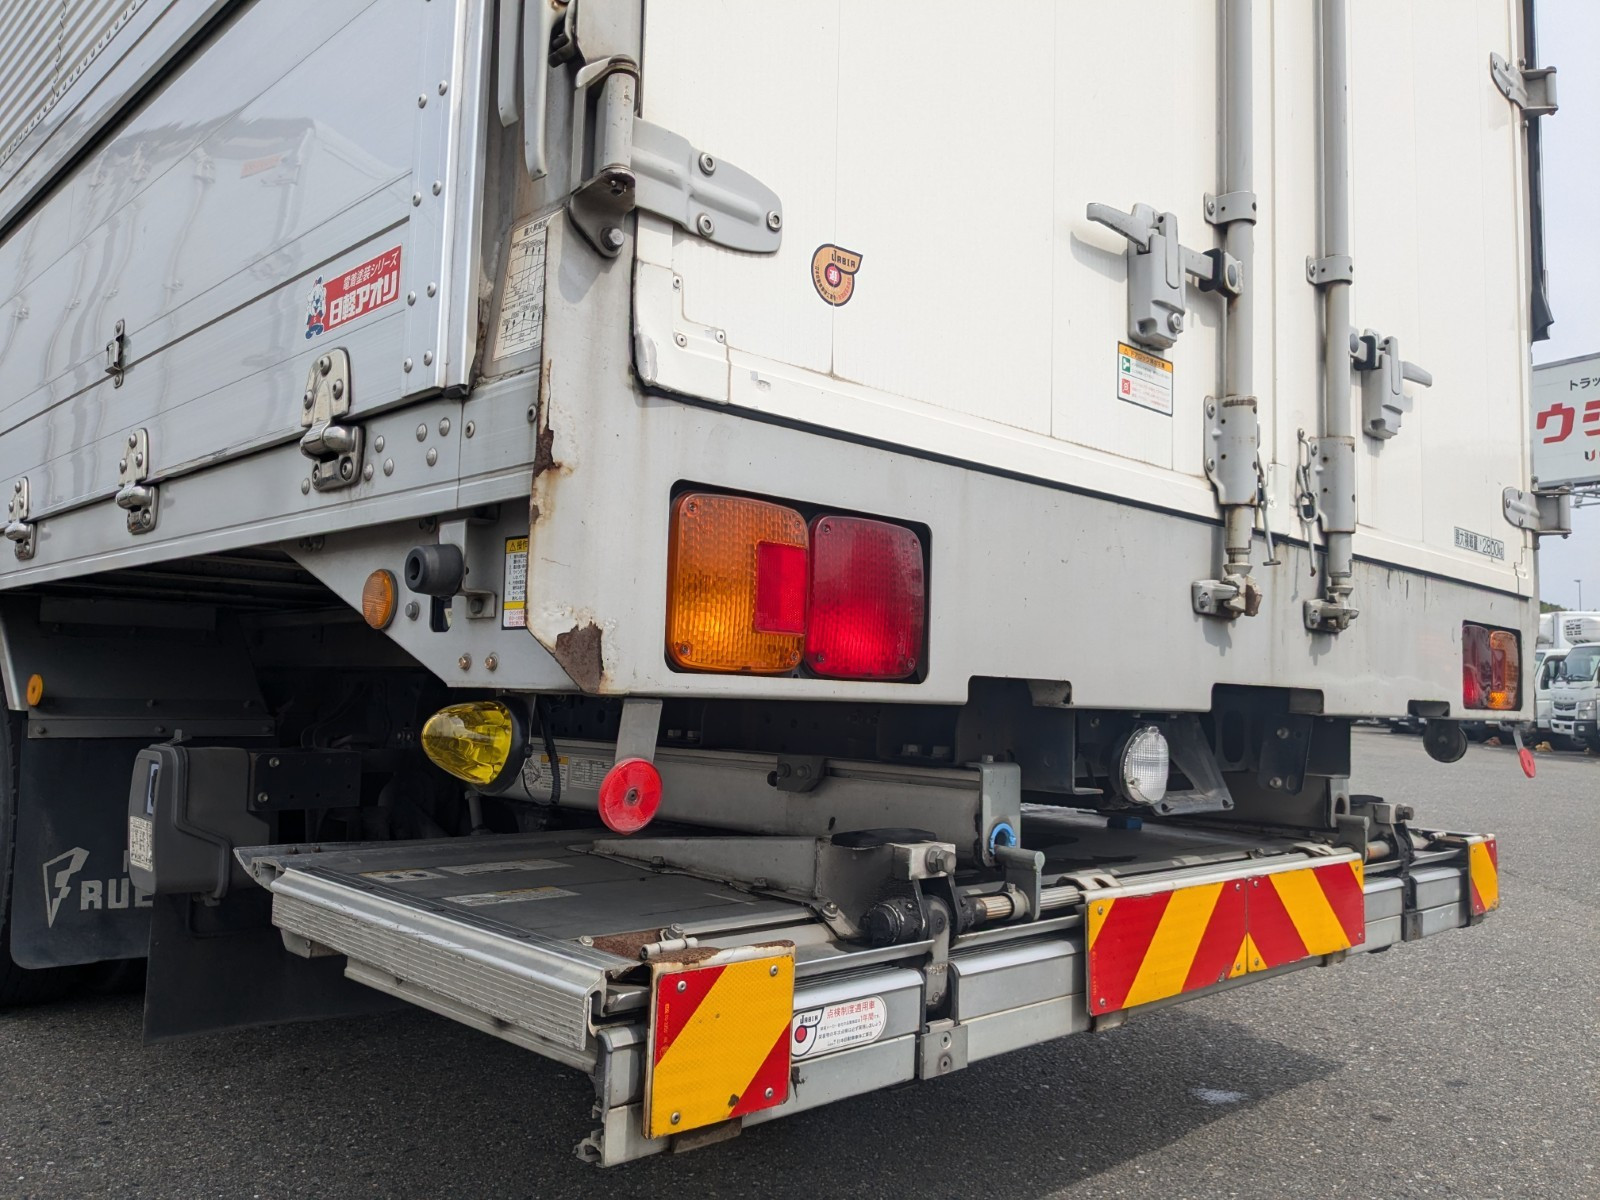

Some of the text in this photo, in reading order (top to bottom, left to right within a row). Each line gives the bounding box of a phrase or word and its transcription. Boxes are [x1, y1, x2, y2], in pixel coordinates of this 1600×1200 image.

[343, 250, 399, 291] 電着塗装シリーズ
[329, 270, 398, 327] 日軽アオリ
[826, 1000, 876, 1019] 点検制度適用車
